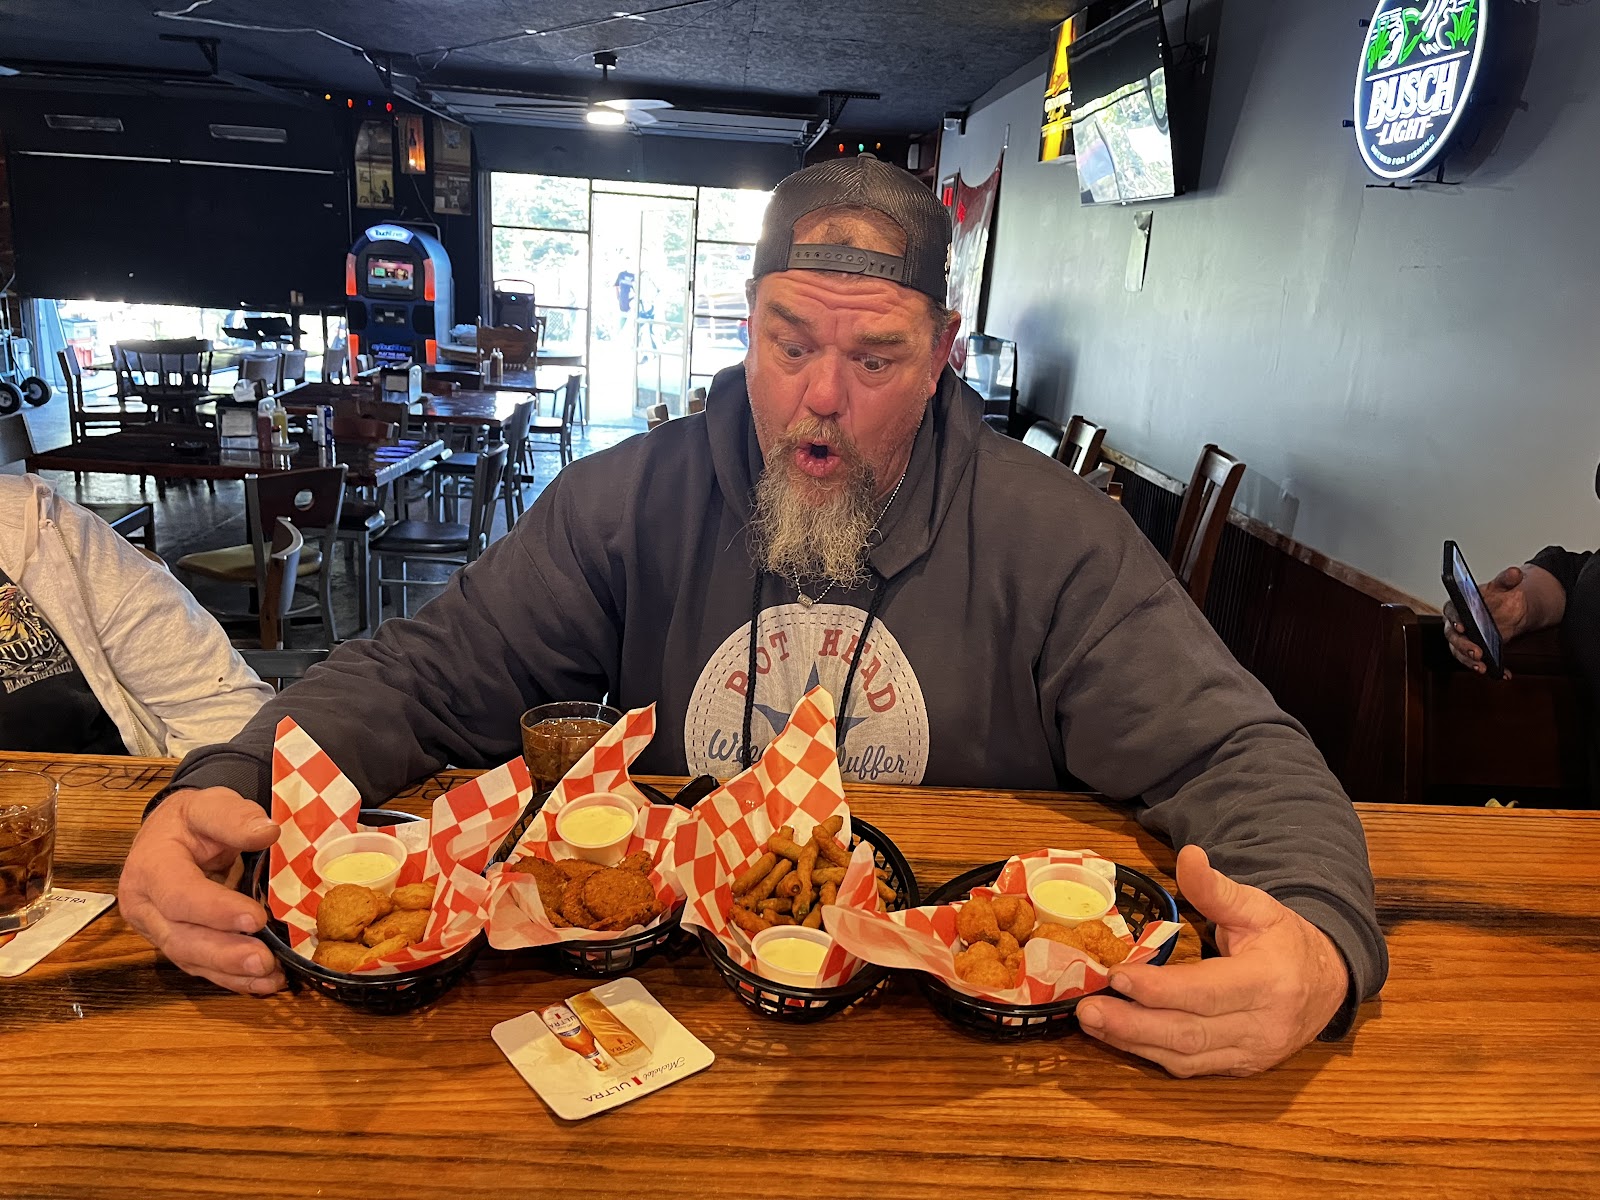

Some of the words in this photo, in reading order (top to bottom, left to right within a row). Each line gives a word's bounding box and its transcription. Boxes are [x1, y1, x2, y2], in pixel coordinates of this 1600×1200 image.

[1365, 60, 1459, 130] BUSCH
[1377, 115, 1432, 146] LIGHT
[724, 630, 790, 697] POT
[818, 628, 896, 713] HEAD
[548, 1015, 577, 1029] ULTRA
[609, 1039, 637, 1053] ULTRA
[583, 1081, 632, 1102] ULTRA
